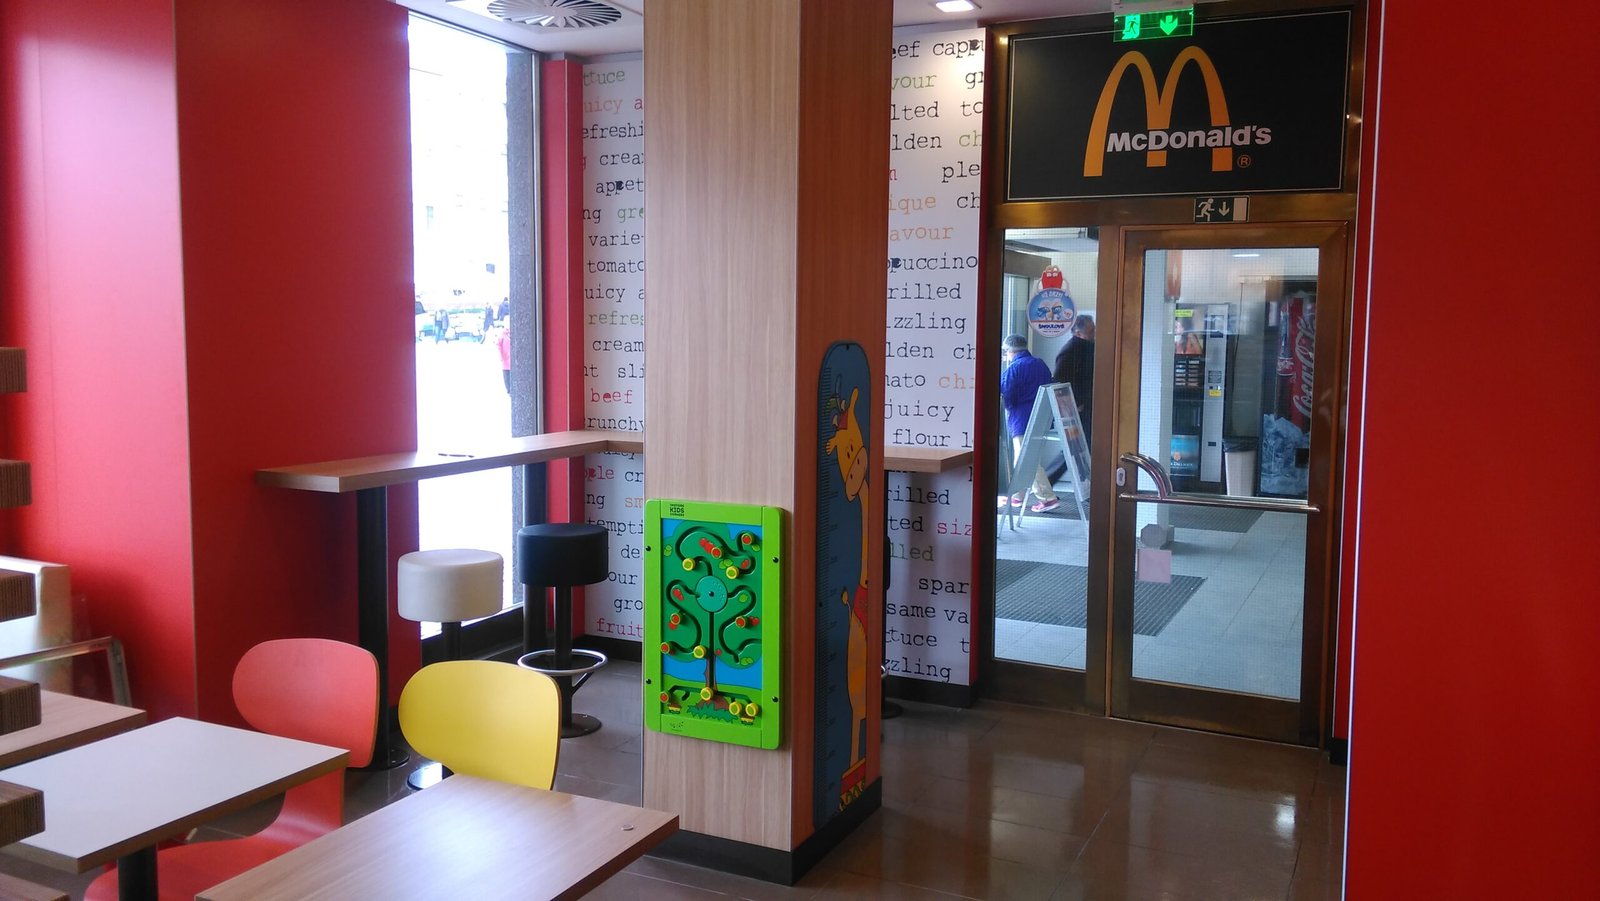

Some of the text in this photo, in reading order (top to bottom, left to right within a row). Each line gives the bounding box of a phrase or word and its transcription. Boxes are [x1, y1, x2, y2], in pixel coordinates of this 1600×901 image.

[1107, 125, 1272, 152] McDonald's
[599, 151, 644, 166] crea
[588, 230, 644, 247] varie
[889, 226, 954, 242] avour
[886, 312, 967, 335] zzling
[590, 388, 633, 404] beef
[885, 399, 955, 422] juicy
[583, 416, 644, 432] runchy
[892, 428, 951, 448] flour
[620, 545, 643, 560] de
[886, 603, 936, 618] same
